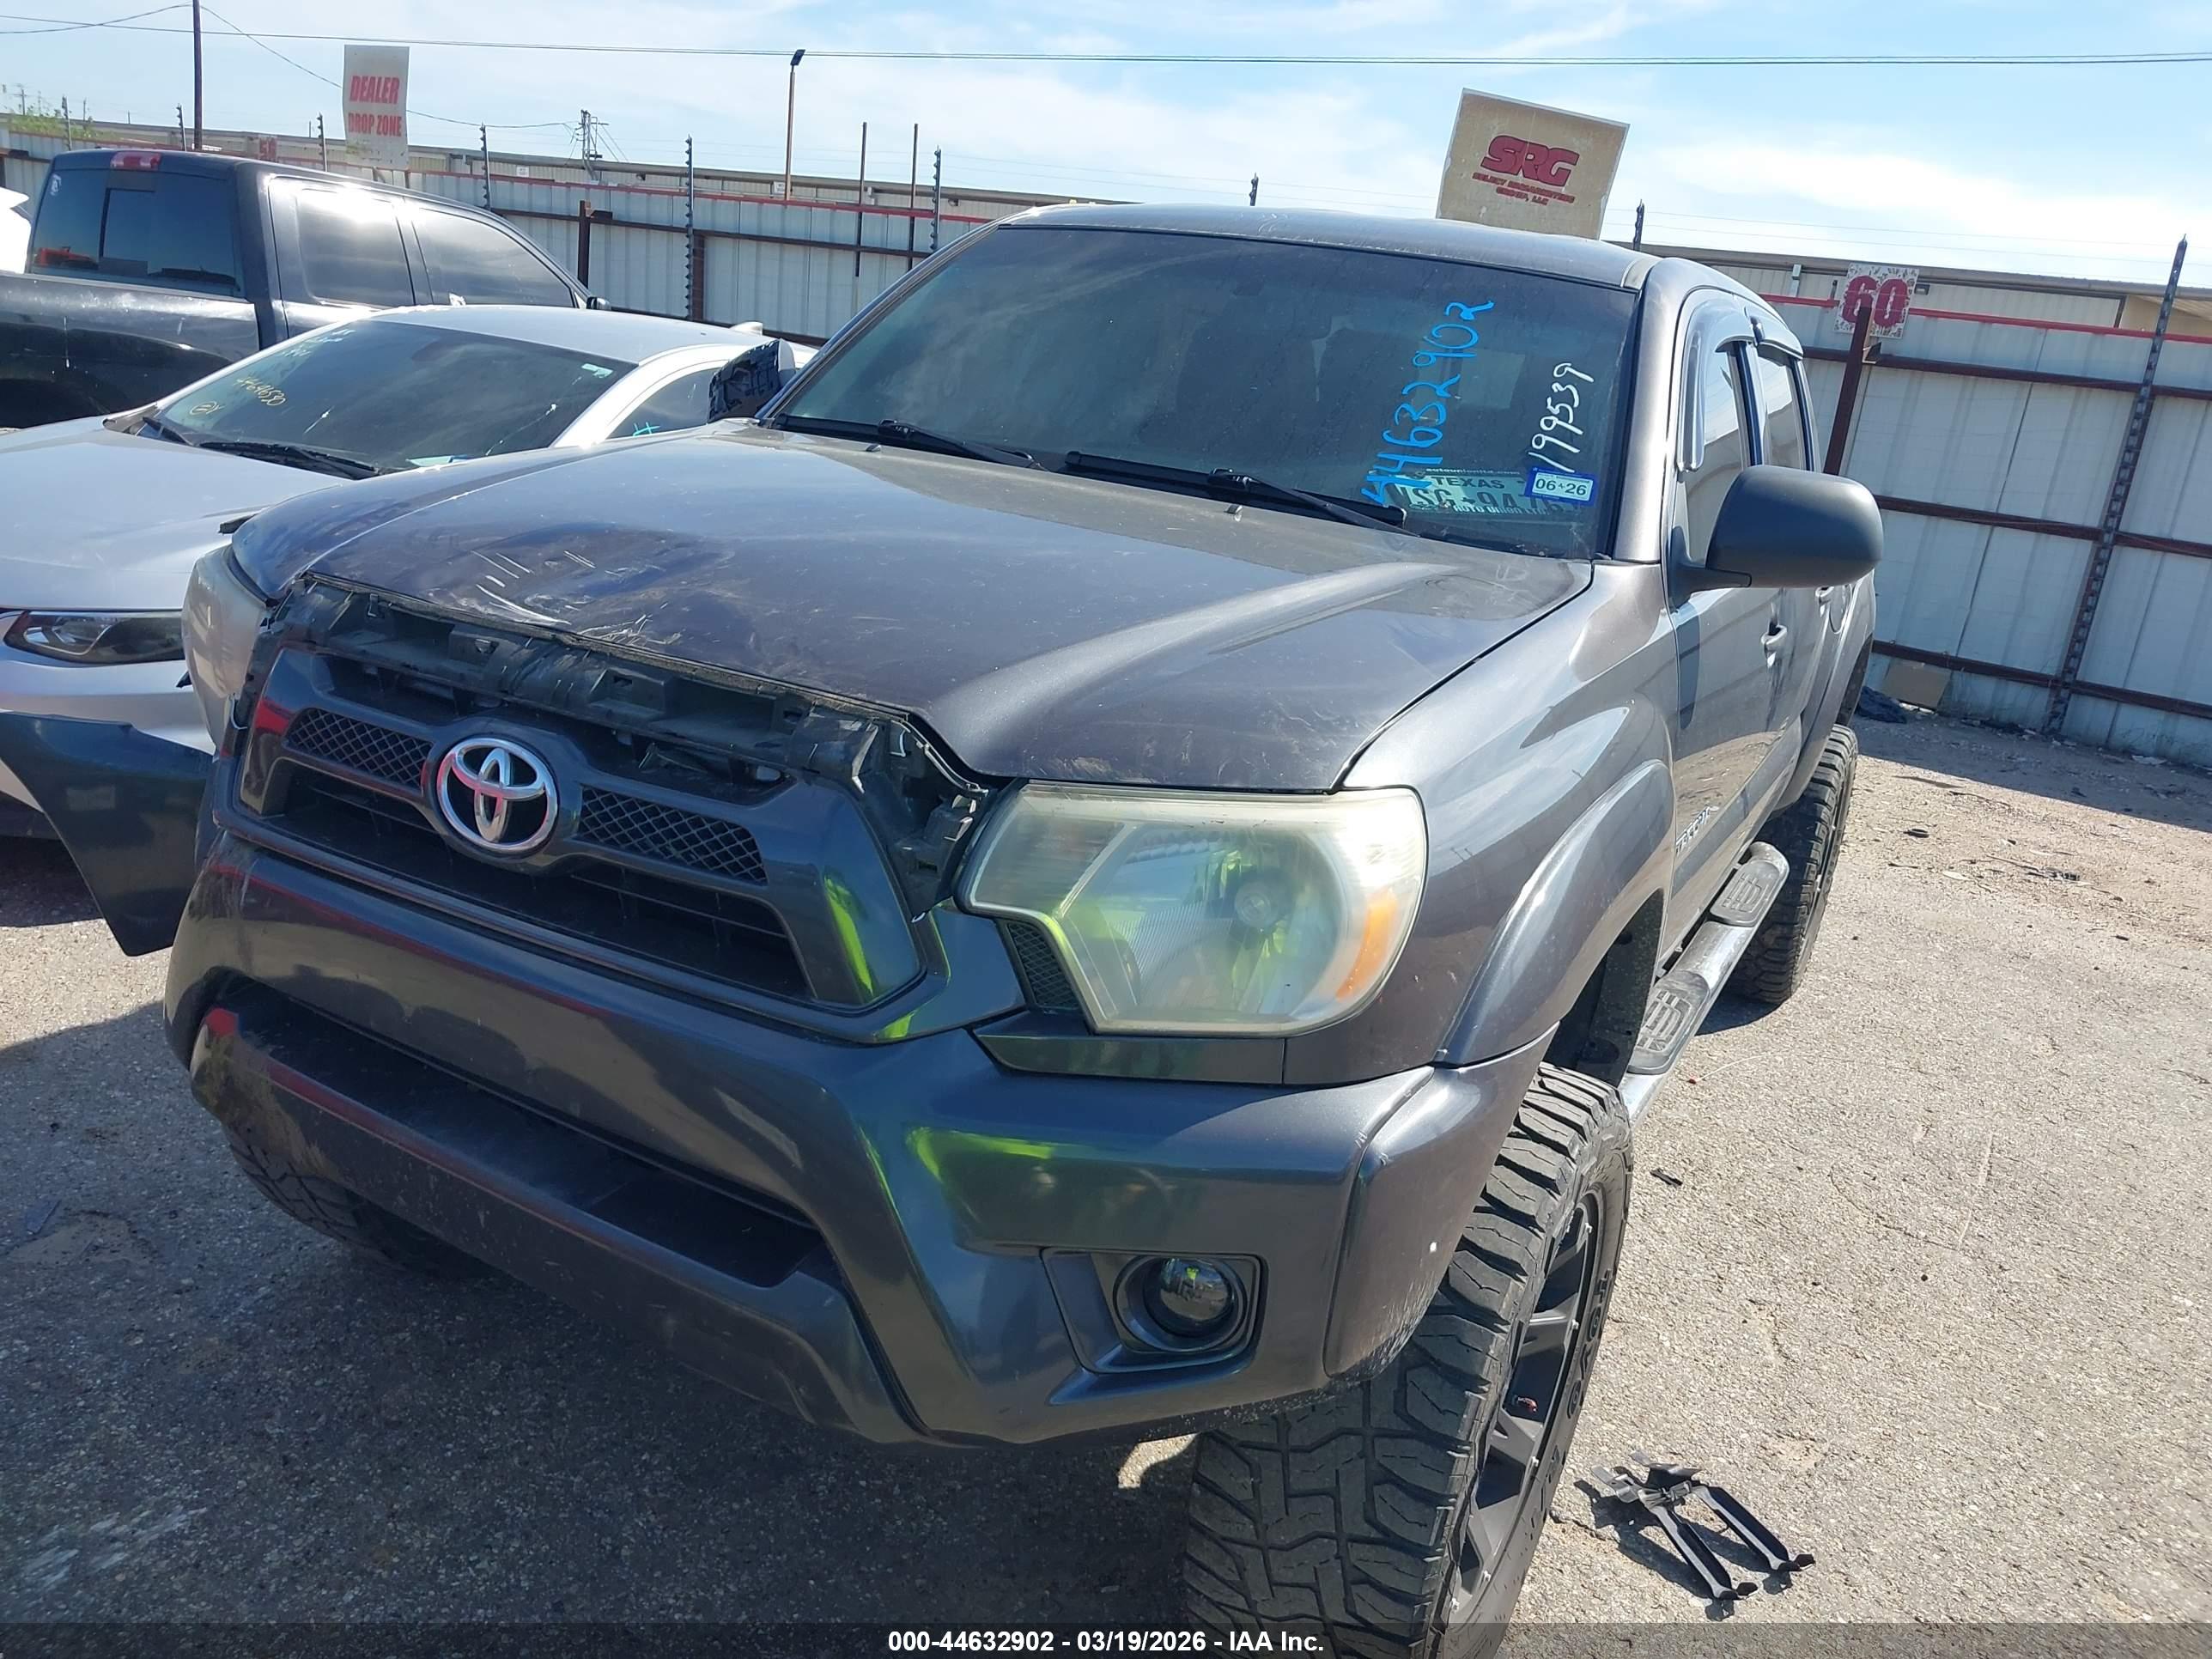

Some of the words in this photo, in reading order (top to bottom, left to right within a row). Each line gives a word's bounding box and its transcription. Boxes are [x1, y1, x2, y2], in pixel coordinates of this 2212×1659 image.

[349, 75, 400, 105] DEALER
[348, 112, 374, 134] DROP
[376, 115, 403, 137] ZONE
[1480, 135, 1580, 186] SRG
[1842, 275, 1908, 327] 60
[1360, 301, 1495, 505] 44632902
[1528, 362, 1594, 473] 199539
[1431, 476, 1505, 489] TEXAS
[1535, 478, 1556, 491] 06
[1565, 483, 1587, 495] 26
